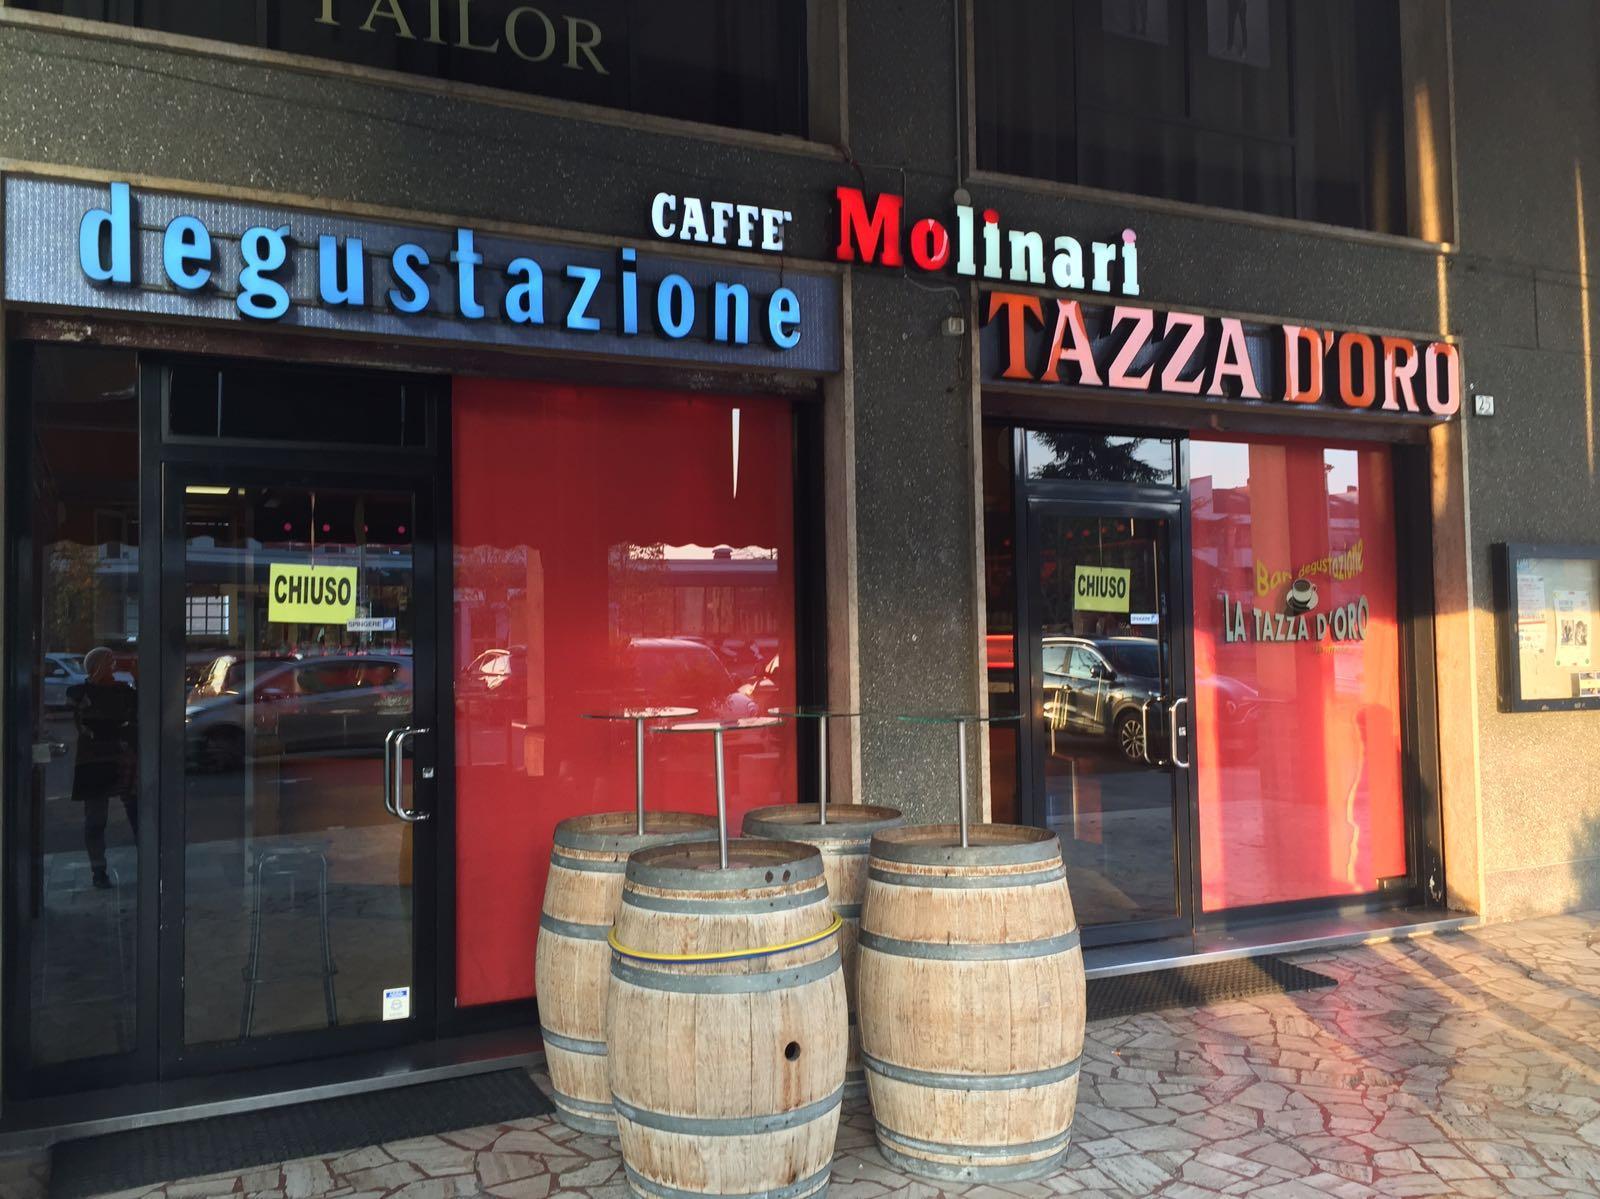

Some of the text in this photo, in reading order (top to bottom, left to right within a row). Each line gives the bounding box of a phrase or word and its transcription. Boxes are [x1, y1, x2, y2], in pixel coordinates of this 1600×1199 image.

[78, 182, 801, 350] degustazione
[836, 187, 1139, 296] Molinari
[989, 291, 1460, 416] TAZZA D'ORO
[274, 575, 352, 606] CHIUSO
[1077, 574, 1126, 599] CHIUSO
[1256, 559, 1292, 597] Bar
[1223, 592, 1369, 642] LA TAZZA D'ORO
